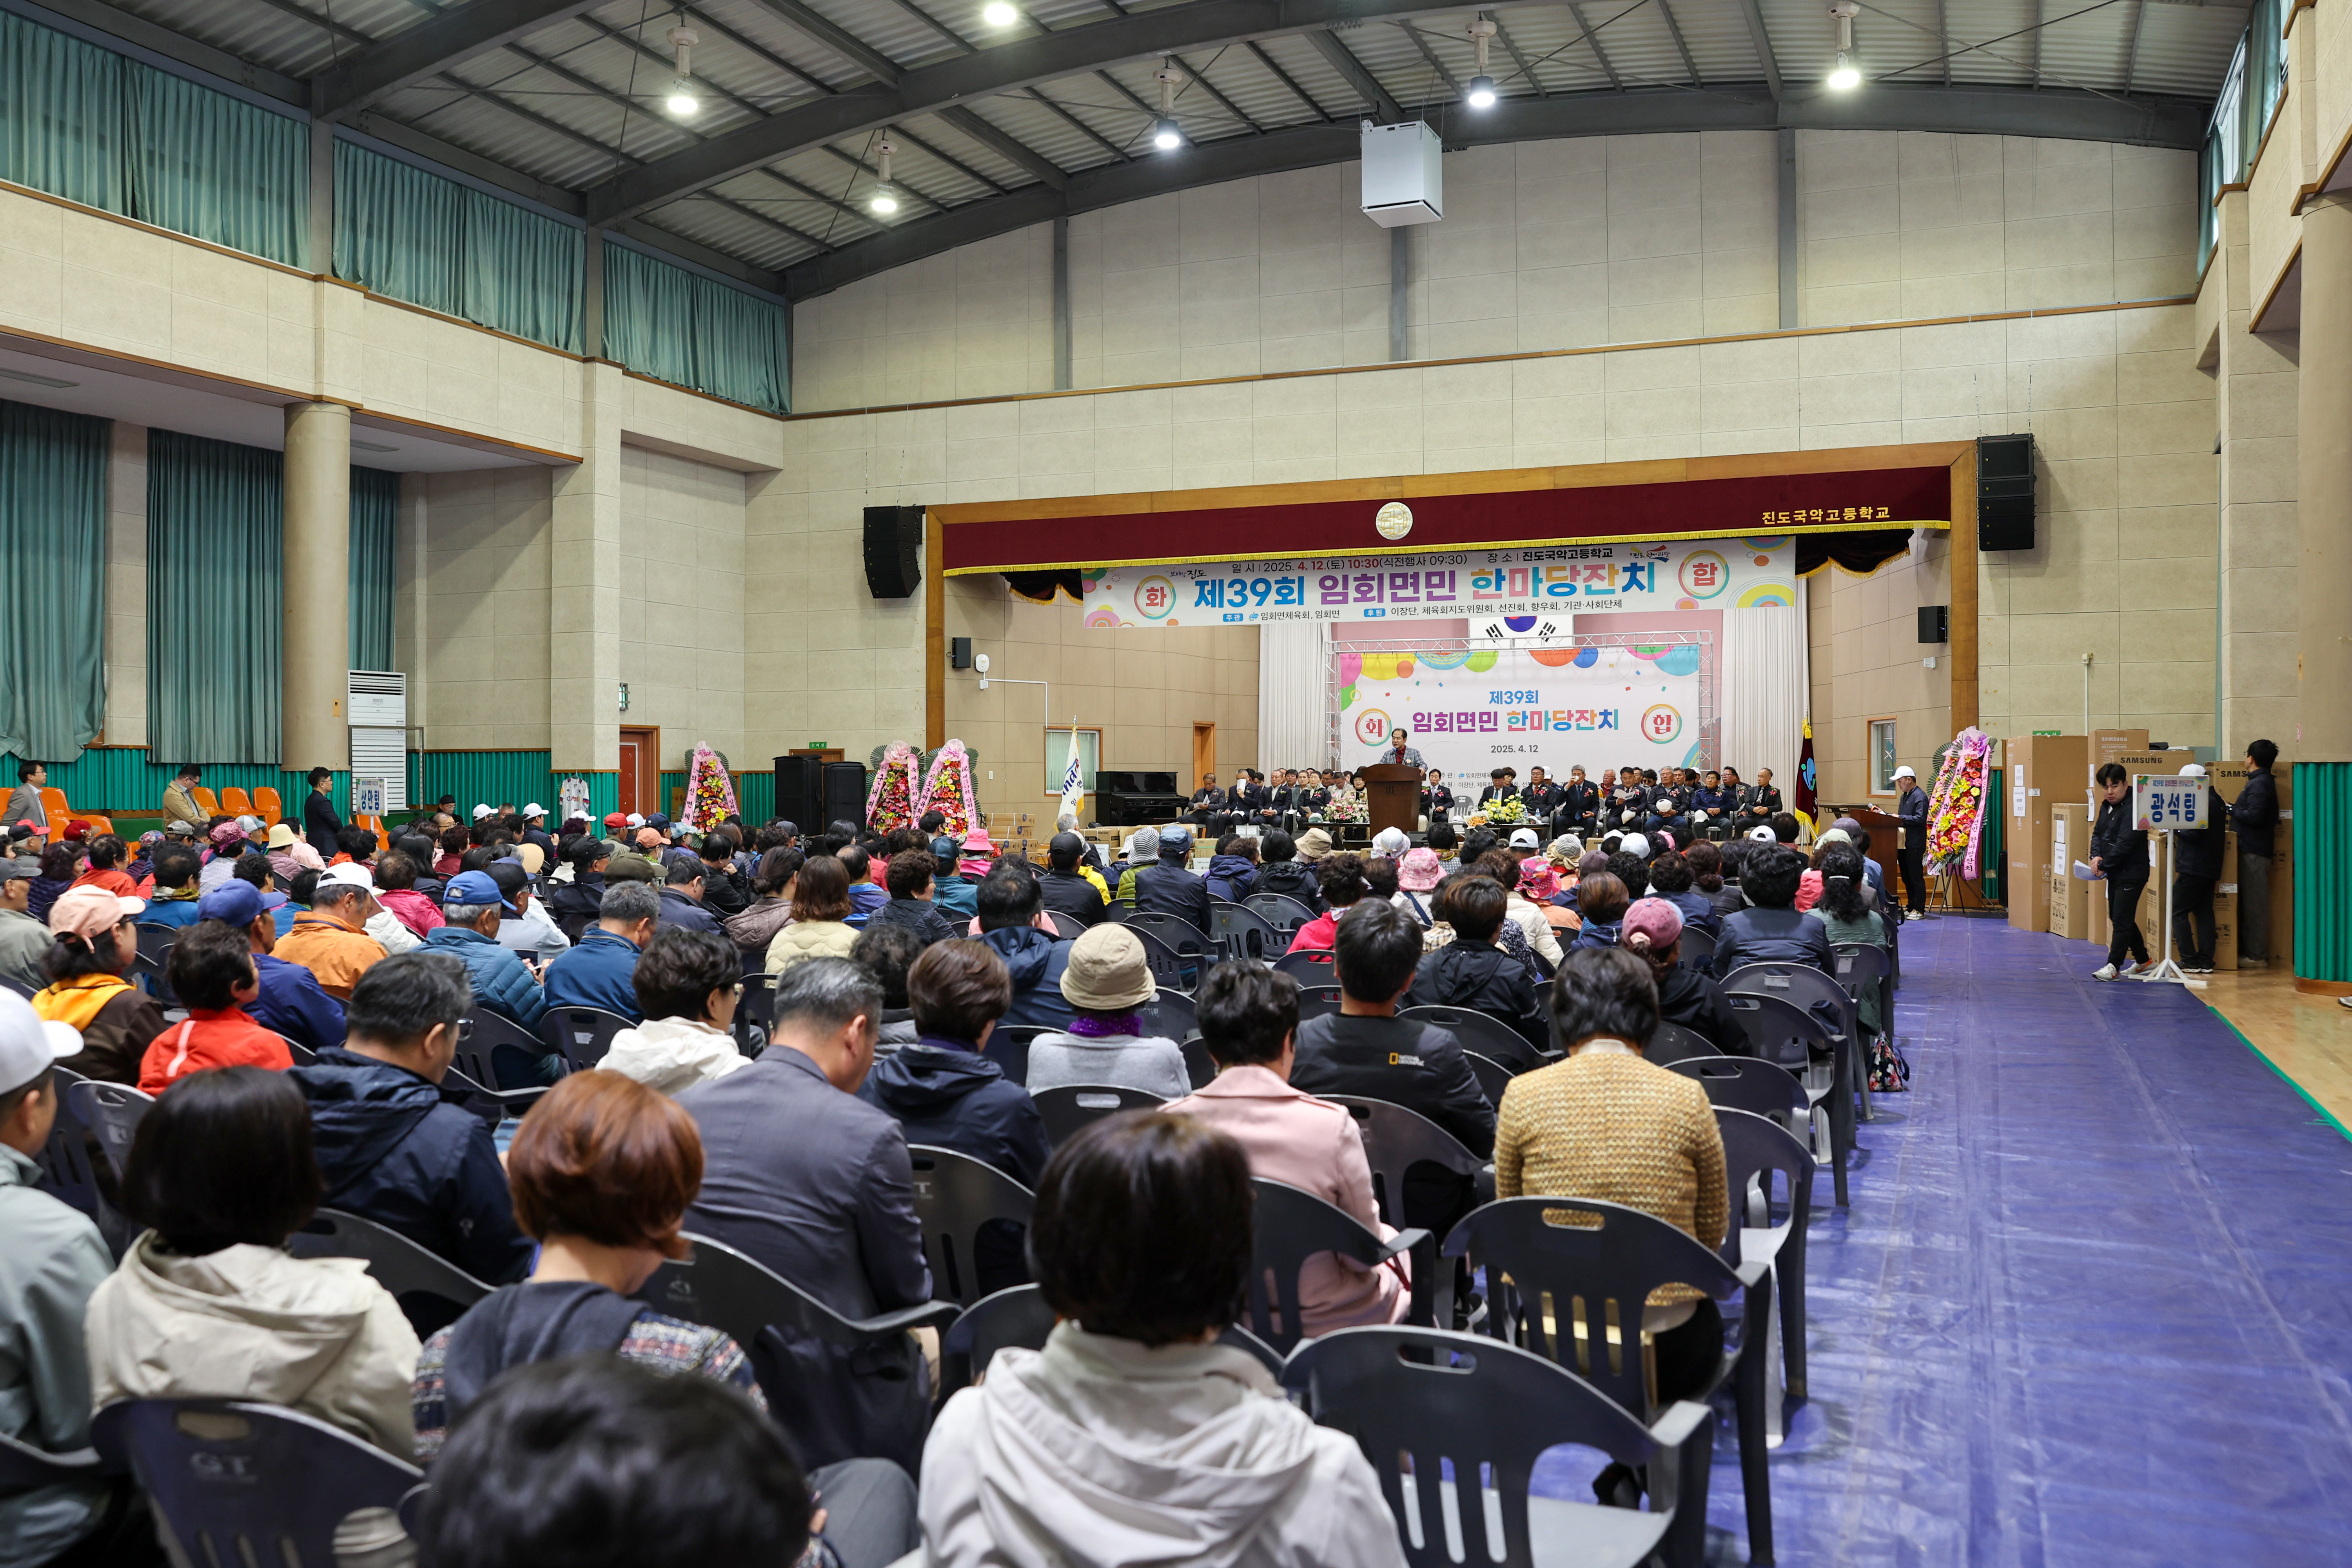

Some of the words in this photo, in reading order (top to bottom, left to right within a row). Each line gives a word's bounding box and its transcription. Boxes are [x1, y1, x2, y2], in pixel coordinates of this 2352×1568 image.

[1762, 506, 1890, 525] 진도국악고등학교
[1263, 562, 1294, 572] 2025.
[1429, 554, 1468, 566] 09:30)
[1522, 548, 1613, 562] 진도국악고등학교
[1187, 569, 1207, 580] 진도
[1194, 576, 1304, 608] 제39회
[1318, 570, 1456, 605] 임회면민
[1470, 561, 1655, 600] 한마당잔치
[1692, 563, 1718, 586] 합
[1145, 587, 1167, 609] 화
[1391, 607, 1419, 616] 이장단,
[1422, 604, 1495, 615] 체육회지도위원회,
[1498, 603, 1528, 613] 선진회,
[1530, 601, 1561, 612] 향우회,
[1564, 599, 1622, 610] 기관·사회단체
[1261, 610, 1313, 621] 임회면체육회,
[1315, 609, 1340, 619] 임회면
[1489, 690, 1539, 705] 제39회
[1365, 718, 1384, 738] 화
[1412, 711, 1498, 733] 임회면민
[1507, 709, 1619, 732] 한마당잔치
[1652, 713, 1673, 735] 합
[1491, 745, 1516, 753] 2025.
[361, 789, 379, 811] 상안팀
[2151, 793, 2196, 823] 광석팀
[1965, 836, 1978, 872] 한마당잔치
